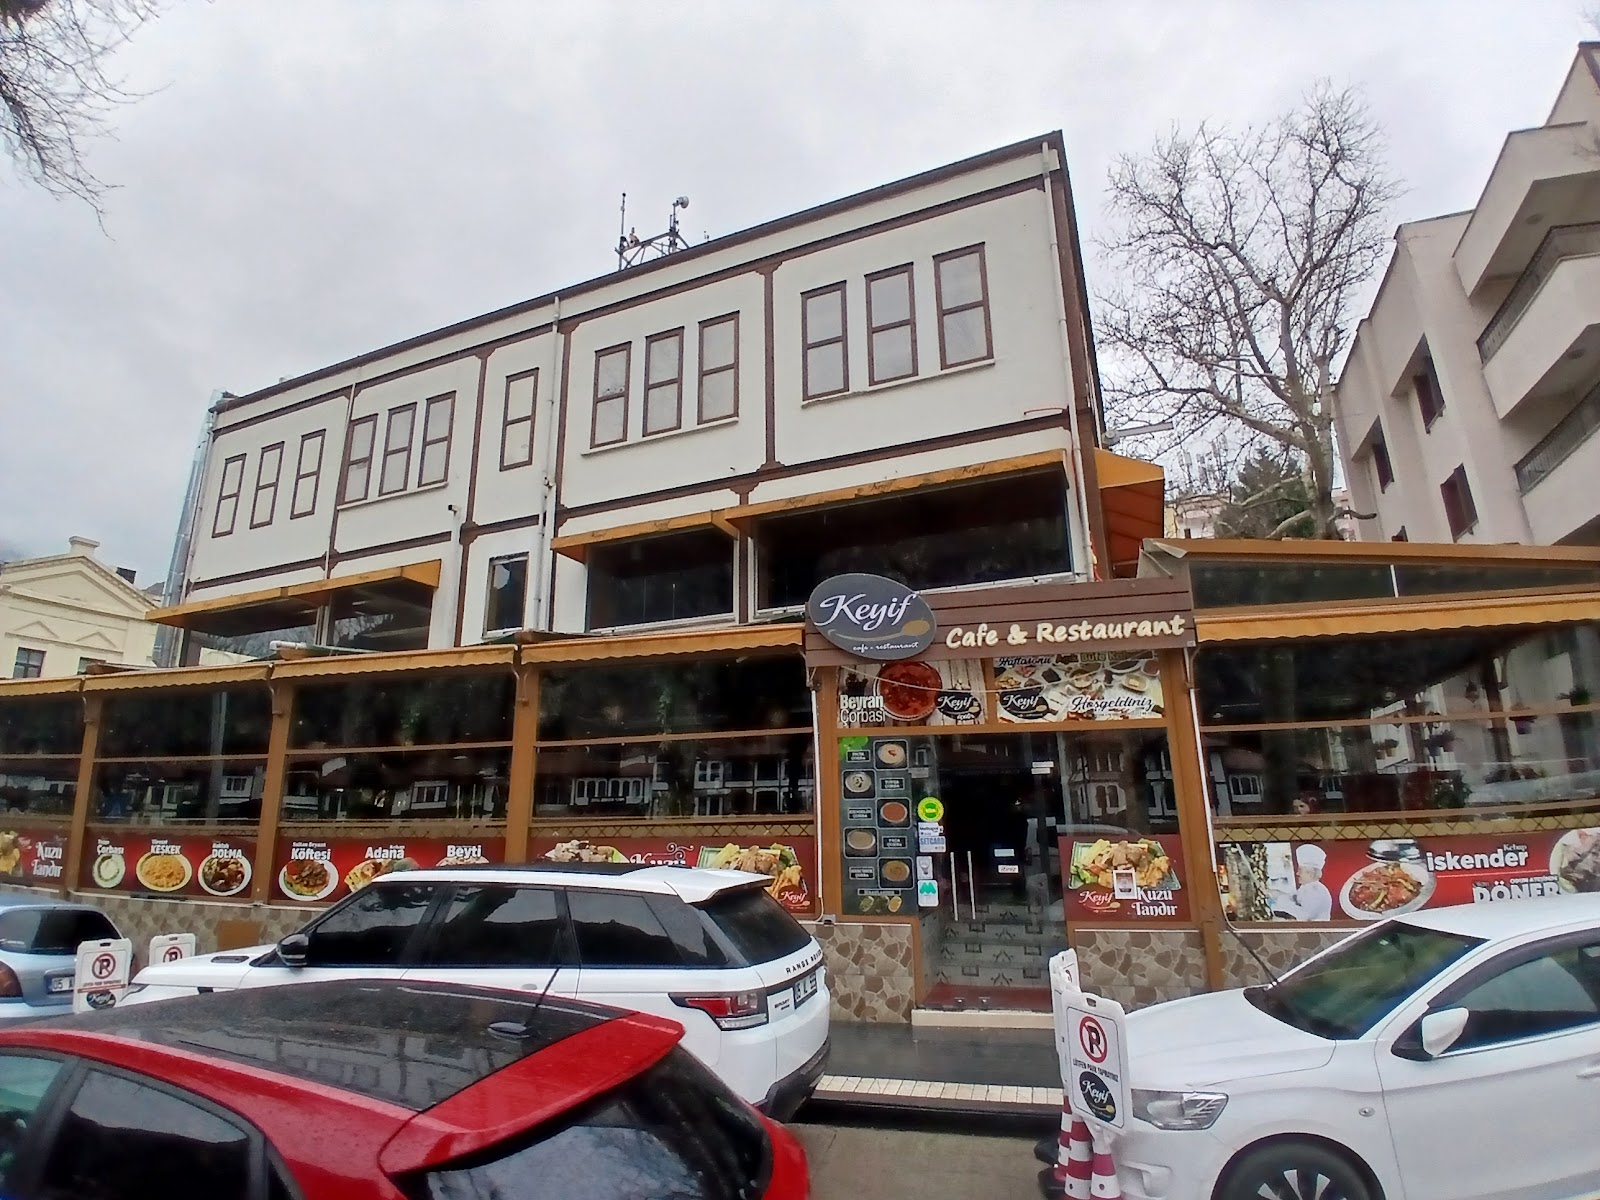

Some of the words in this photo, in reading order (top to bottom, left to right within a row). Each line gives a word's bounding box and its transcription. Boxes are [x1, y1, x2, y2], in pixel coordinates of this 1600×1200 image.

[814, 593, 917, 631] Keyif
[946, 623, 999, 648] Cafe
[1006, 624, 1028, 645] &
[1036, 614, 1186, 643] Restaurant
[839, 694, 884, 711] Beyran
[938, 695, 976, 710] Keyif
[1003, 694, 1041, 710] Keyif
[35, 841, 62, 860] Kuzu
[150, 844, 181, 856] KEŞKEK
[211, 848, 243, 859] DOLMA
[291, 848, 331, 860] Köftesi
[365, 846, 405, 859] Adana
[446, 844, 482, 858] Beyti
[1426, 849, 1529, 871] iskender
[776, 891, 807, 904] Keyif
[1079, 891, 1115, 905] Keyif
[1137, 886, 1173, 903] Kuzu
[1472, 880, 1559, 902] DÖNER
[1131, 901, 1178, 917] Tandır
[785, 959, 809, 975] RANGE
[1081, 1080, 1110, 1104] Keyif
